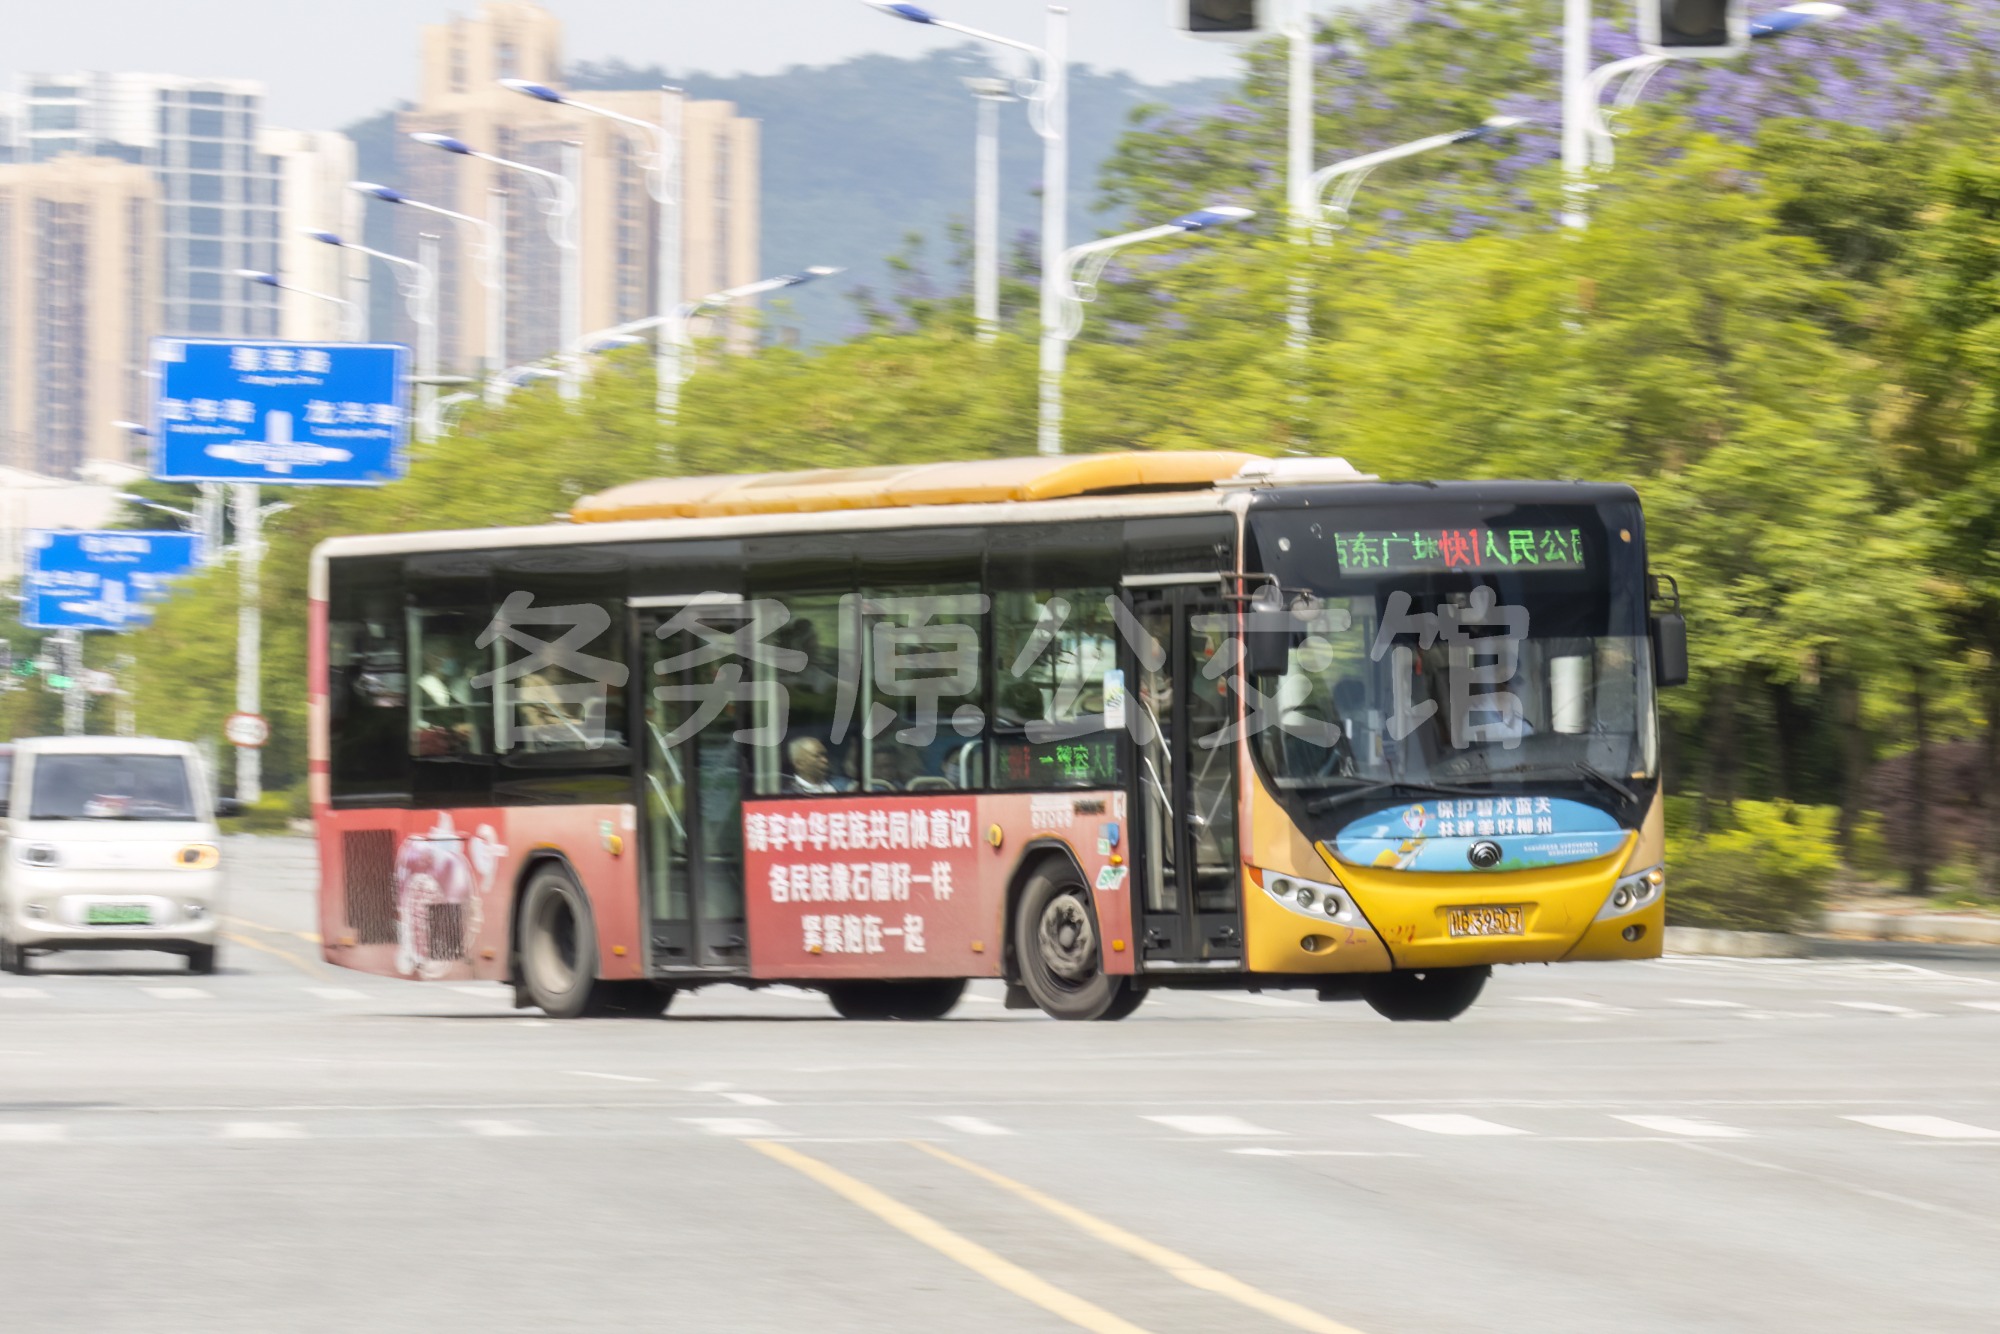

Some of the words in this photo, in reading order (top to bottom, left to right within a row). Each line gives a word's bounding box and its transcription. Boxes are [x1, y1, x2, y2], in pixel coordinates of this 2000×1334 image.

[1437, 797, 1551, 819] 保护碧水蓝天
[746, 809, 972, 852] 铸牢中华民族共同体意识
[769, 861, 953, 902] 各民族像石榴籽一样
[801, 913, 926, 953] 紧紧抱在一起
